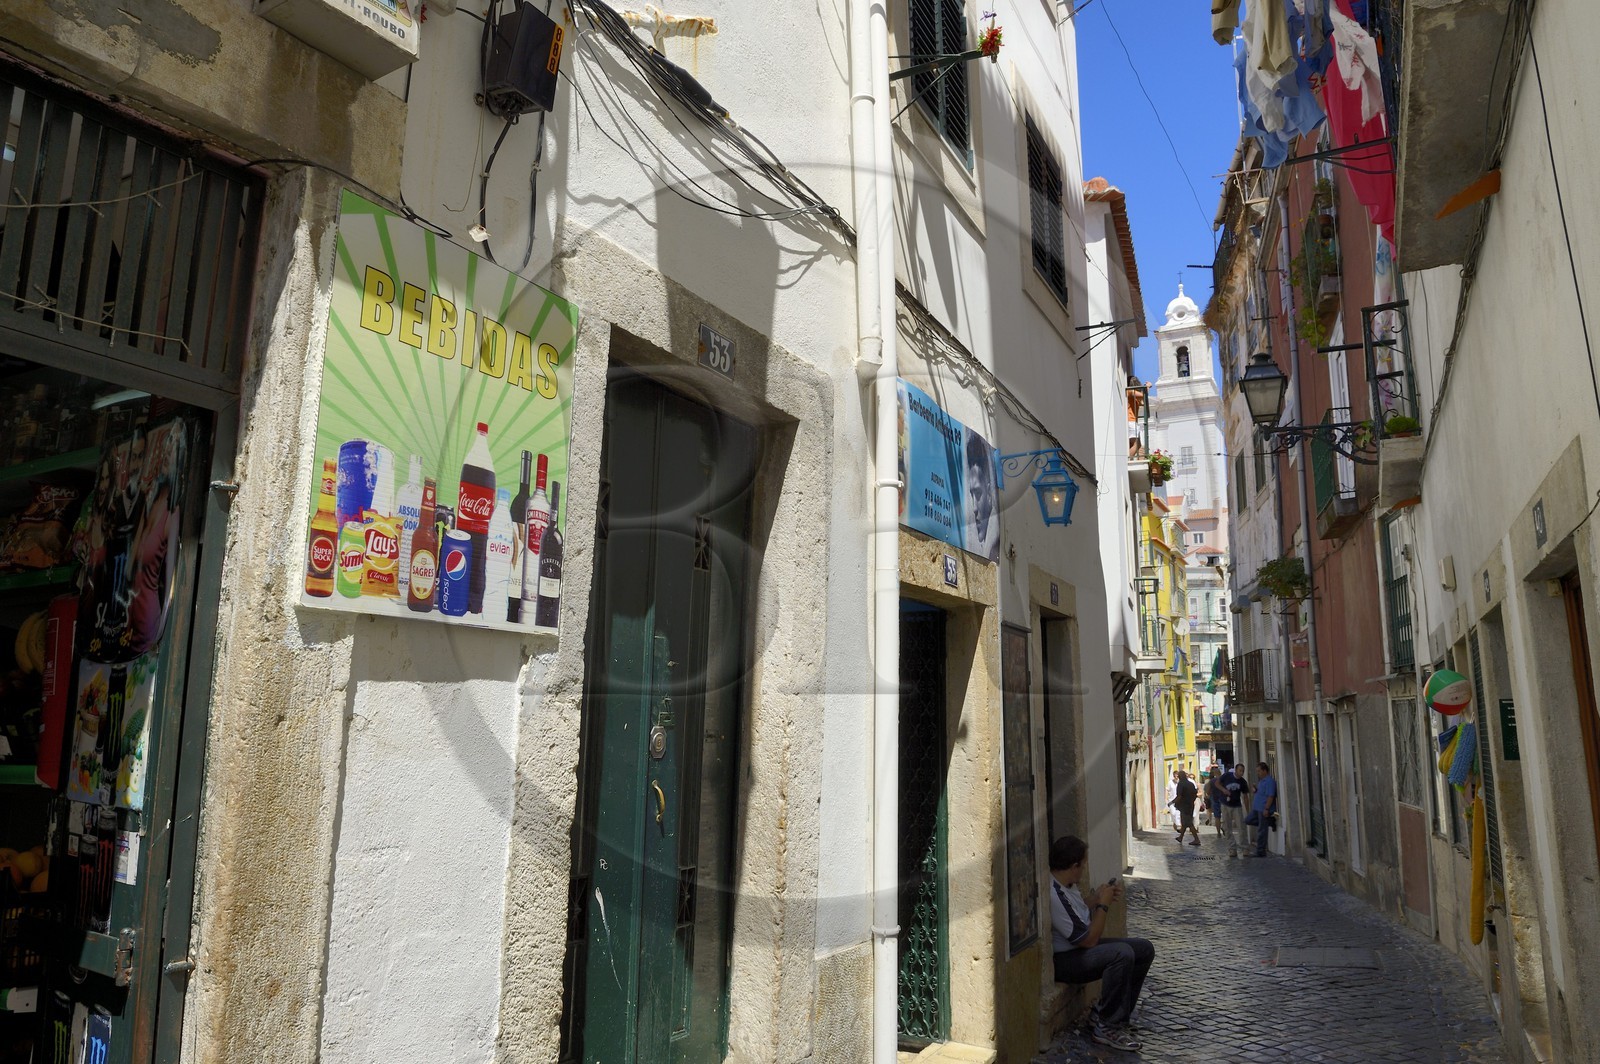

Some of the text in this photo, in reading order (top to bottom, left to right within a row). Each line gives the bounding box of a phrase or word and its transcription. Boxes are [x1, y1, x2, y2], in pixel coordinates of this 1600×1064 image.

[360, 265, 559, 400] BEBIDAS
[709, 332, 731, 373] 53
[460, 492, 491, 516] Coca-Cola
[313, 545, 333, 555] SUPER
[313, 552, 332, 562] BOCK
[489, 541, 511, 555] evian
[412, 565, 434, 578] SAGRES
[946, 557, 956, 584] 55
[442, 578, 450, 611] pepsi
